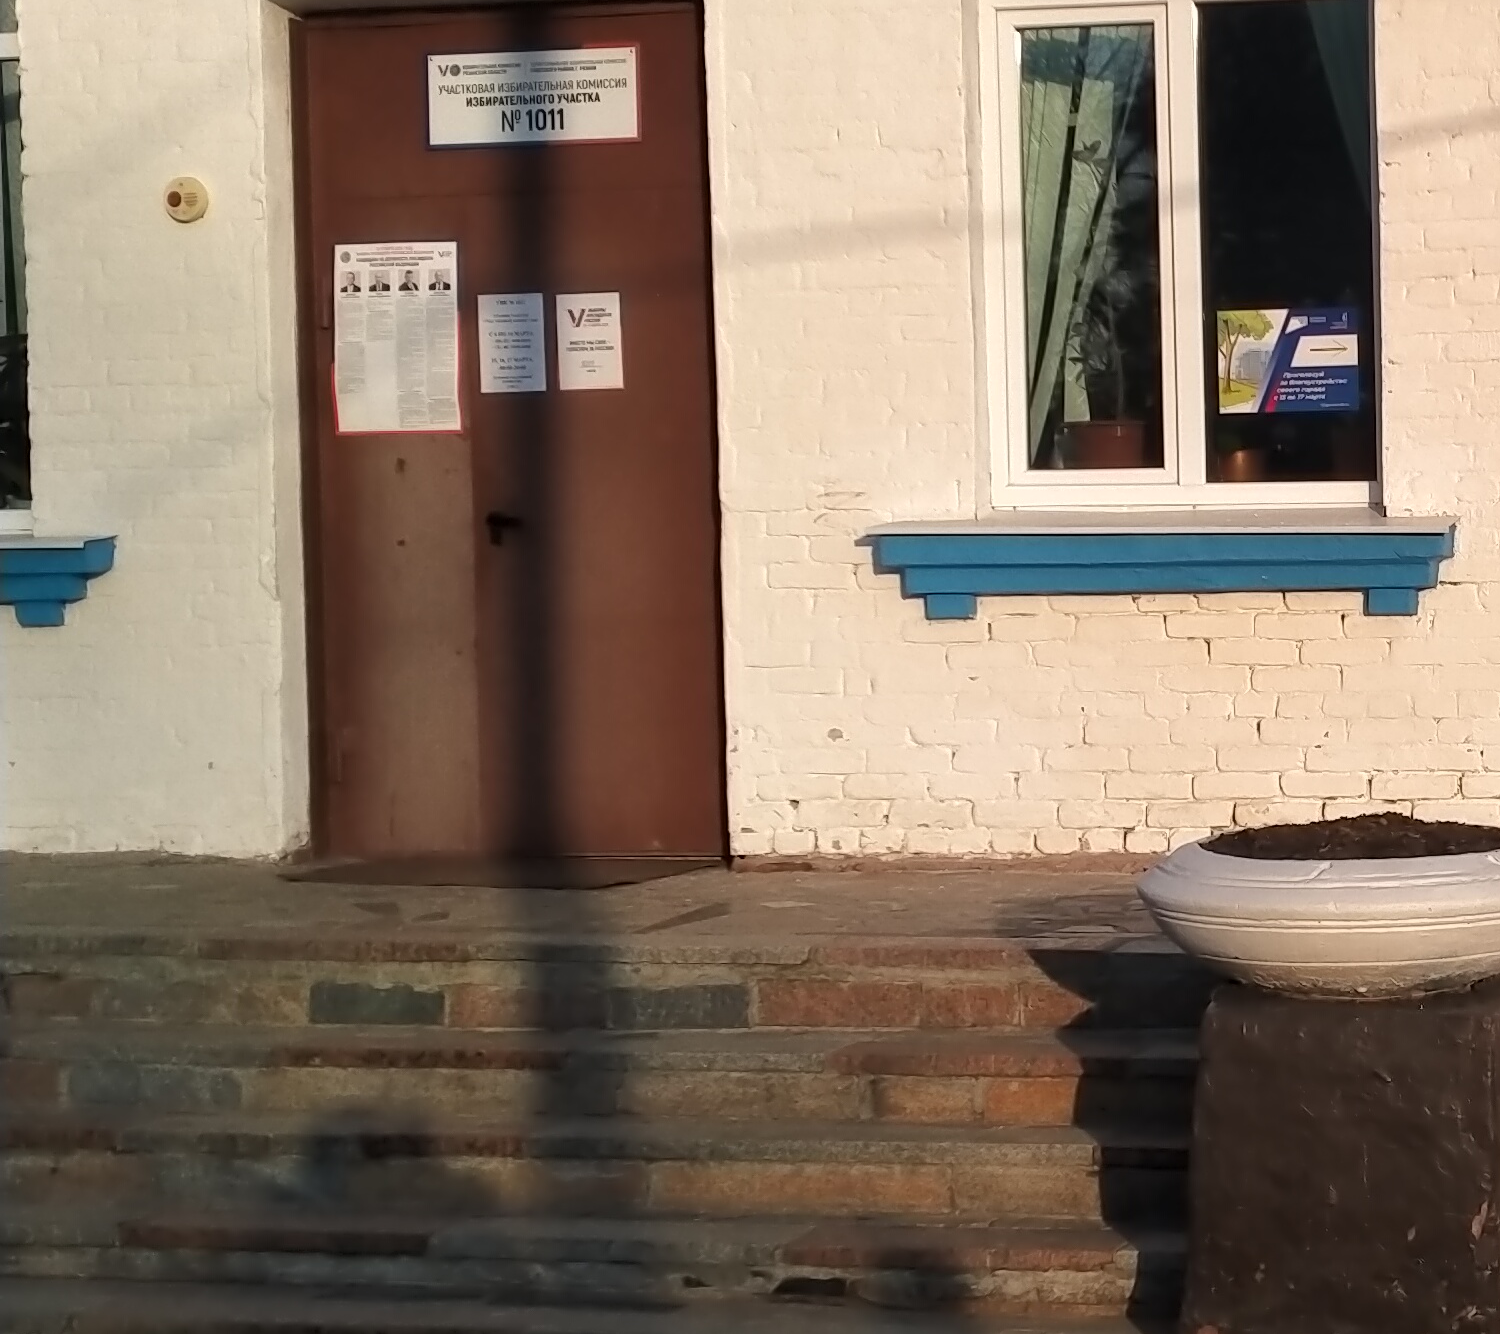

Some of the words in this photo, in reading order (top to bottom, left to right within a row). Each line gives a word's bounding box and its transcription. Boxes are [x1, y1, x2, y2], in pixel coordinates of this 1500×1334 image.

[438, 83, 495, 95] УЧАСТКОВАЯ
[498, 80, 574, 92] ИЗБИРАТЕЛЬНАЯ
[576, 77, 628, 89] КОМИССИЯ
[466, 94, 555, 107] ИЗБИРАТЕЛЬНОГО
[557, 92, 601, 104] УЧАСТКА
[501, 109, 522, 133] №
[525, 108, 565, 131] 1011
